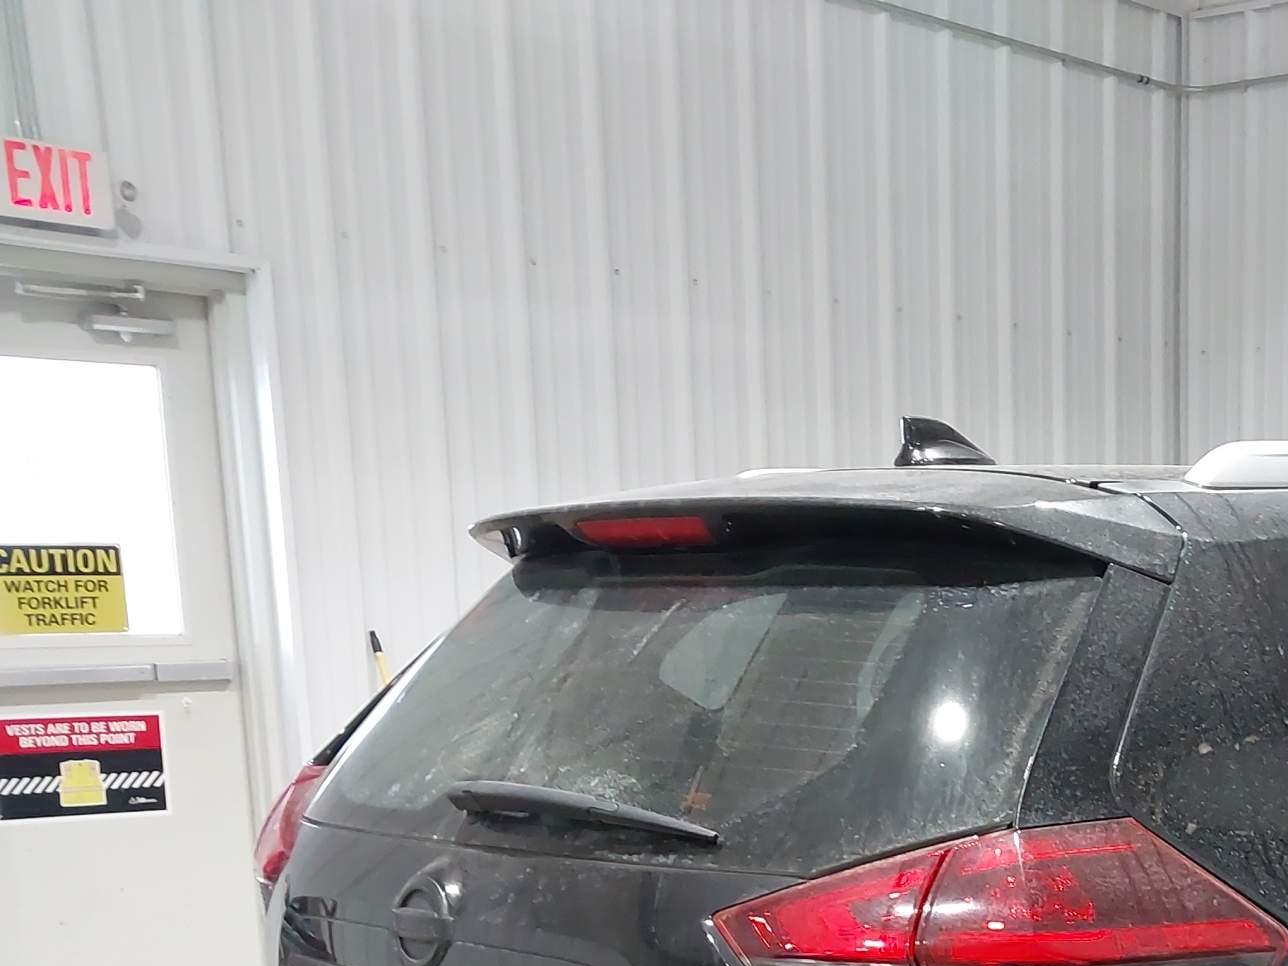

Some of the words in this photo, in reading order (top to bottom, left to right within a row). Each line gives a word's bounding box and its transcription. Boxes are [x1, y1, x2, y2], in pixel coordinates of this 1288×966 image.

[3, 139, 92, 215] EXIT
[4, 579, 69, 593] WATCH
[74, 579, 109, 592] FOR
[17, 596, 99, 610] FORKLIFT
[24, 612, 97, 626] TRAFFIC
[5, 723, 45, 737] VESTS
[46, 722, 72, 735] ARE
[72, 721, 89, 734] TO
[90, 721, 109, 733] BE
[107, 720, 147, 732] WORN
[18, 735, 69, 748] BEYOND
[70, 734, 98, 746] THIS
[99, 732, 136, 744] POINT
